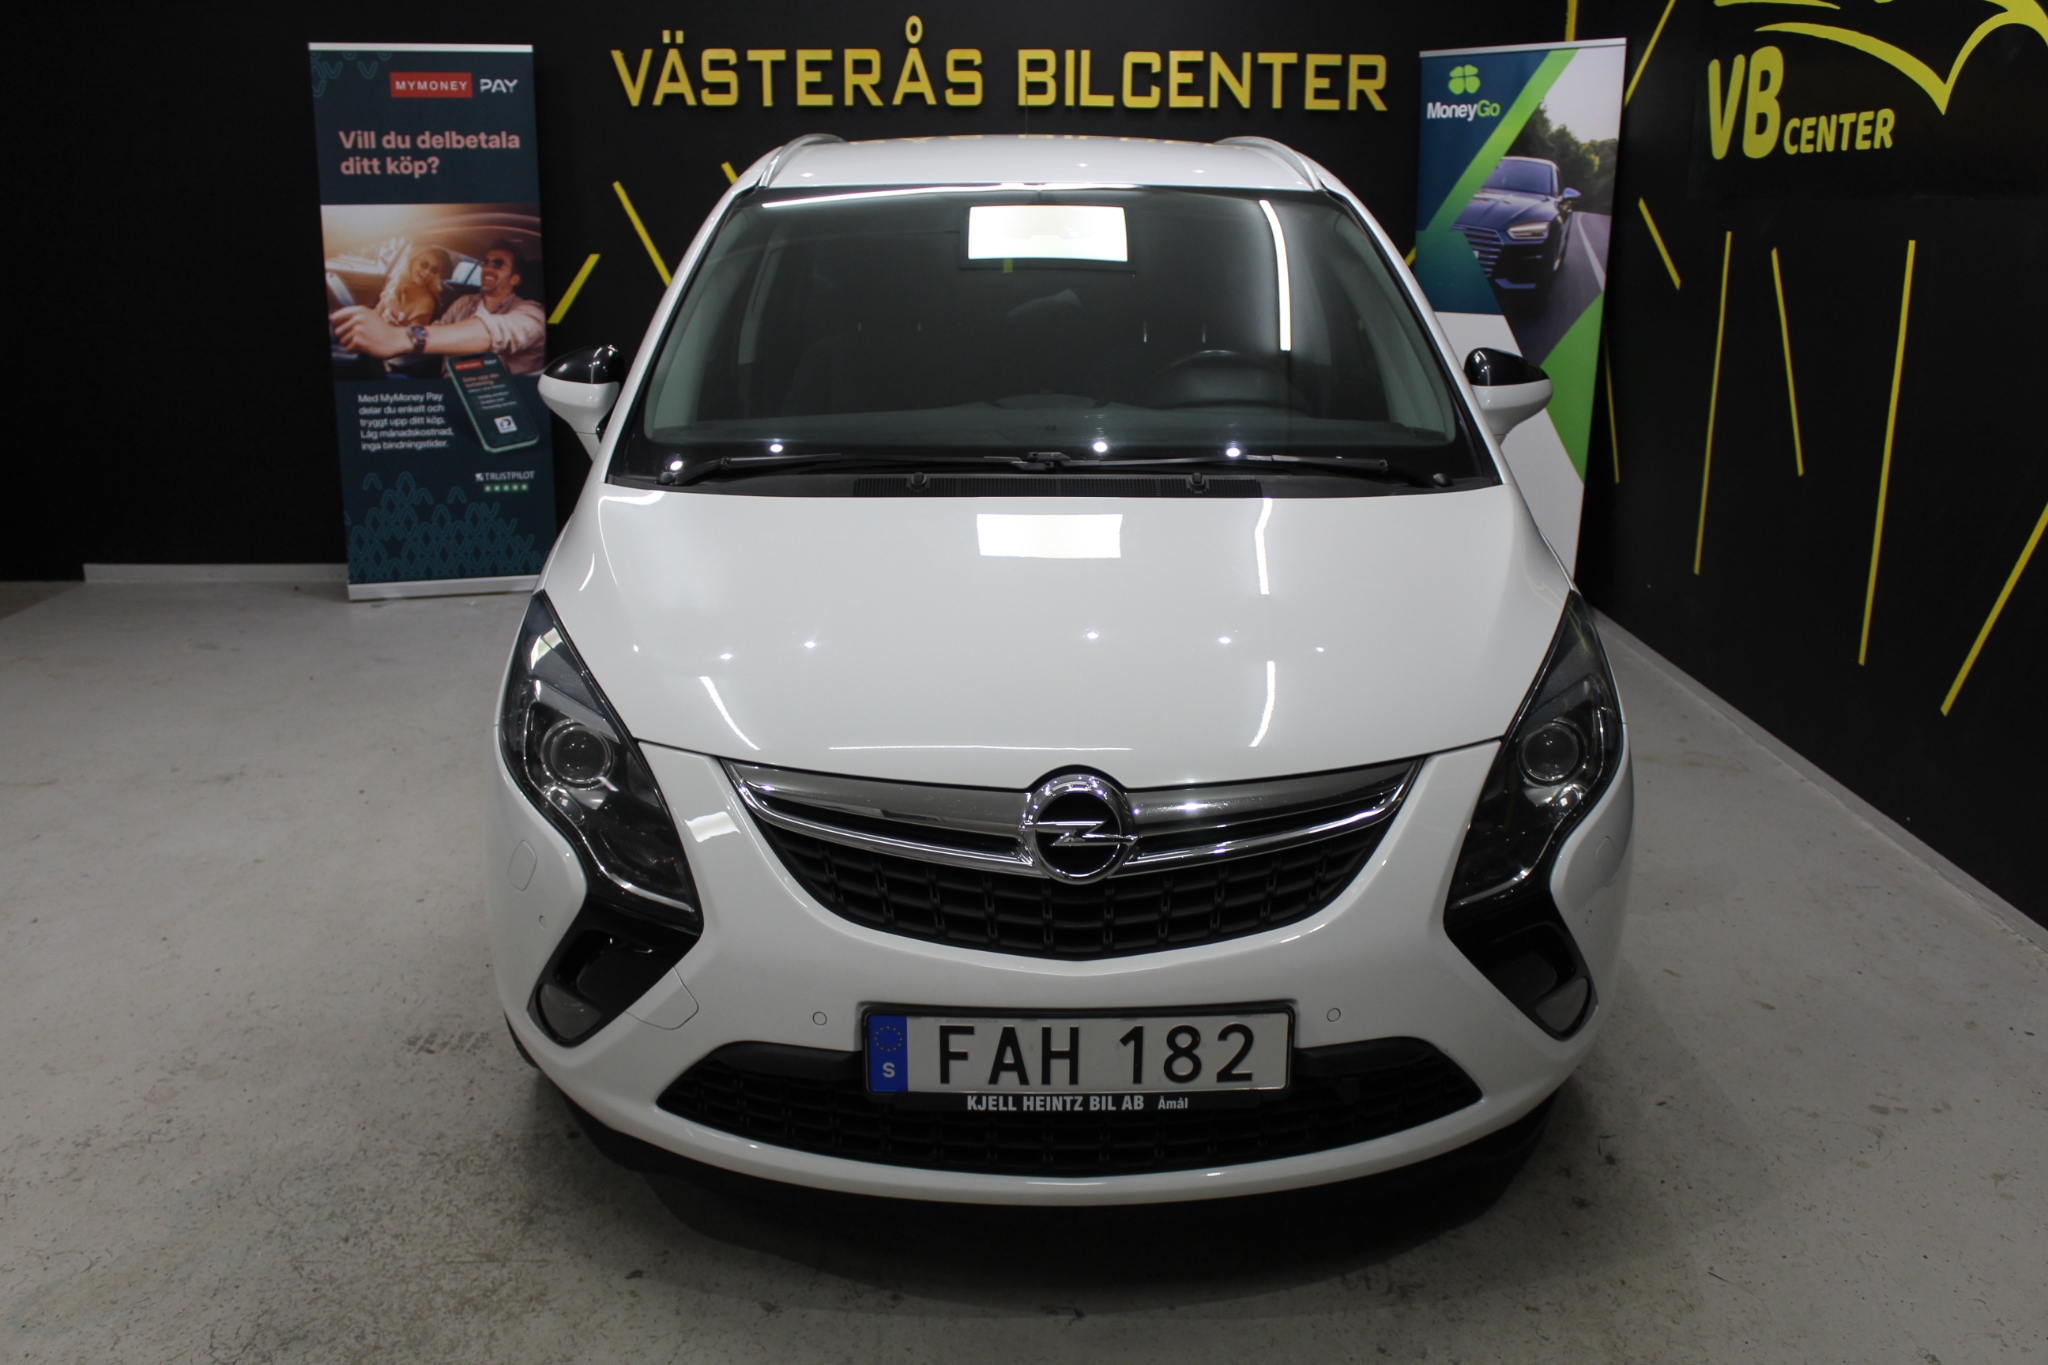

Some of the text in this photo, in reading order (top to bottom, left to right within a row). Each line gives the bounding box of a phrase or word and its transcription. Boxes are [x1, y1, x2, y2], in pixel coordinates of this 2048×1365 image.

[610, 15, 1388, 111] VÄSTERÅS BILCENTER
[395, 78, 518, 93] MYMONEY PAY
[1426, 99, 1501, 121] MoneyGo
[1708, 45, 1895, 160] VB CENTER
[338, 130, 521, 149] Vill du delbetala
[340, 155, 440, 179] ditt köp?
[358, 392, 443, 404] Med MyMoney Pay
[359, 404, 445, 415] delar du enkelt och
[360, 415, 445, 428] tryggt upp ditt köp.
[360, 429, 378, 440] Låg
[361, 441, 381, 452] inga
[484, 471, 535, 480] TRUSTPILOT
[939, 1023, 1255, 1086] FAH 182
[882, 1062, 896, 1078] S
[967, 1095, 1189, 1111] KJELL HEINTZ BIL AB Åmål
